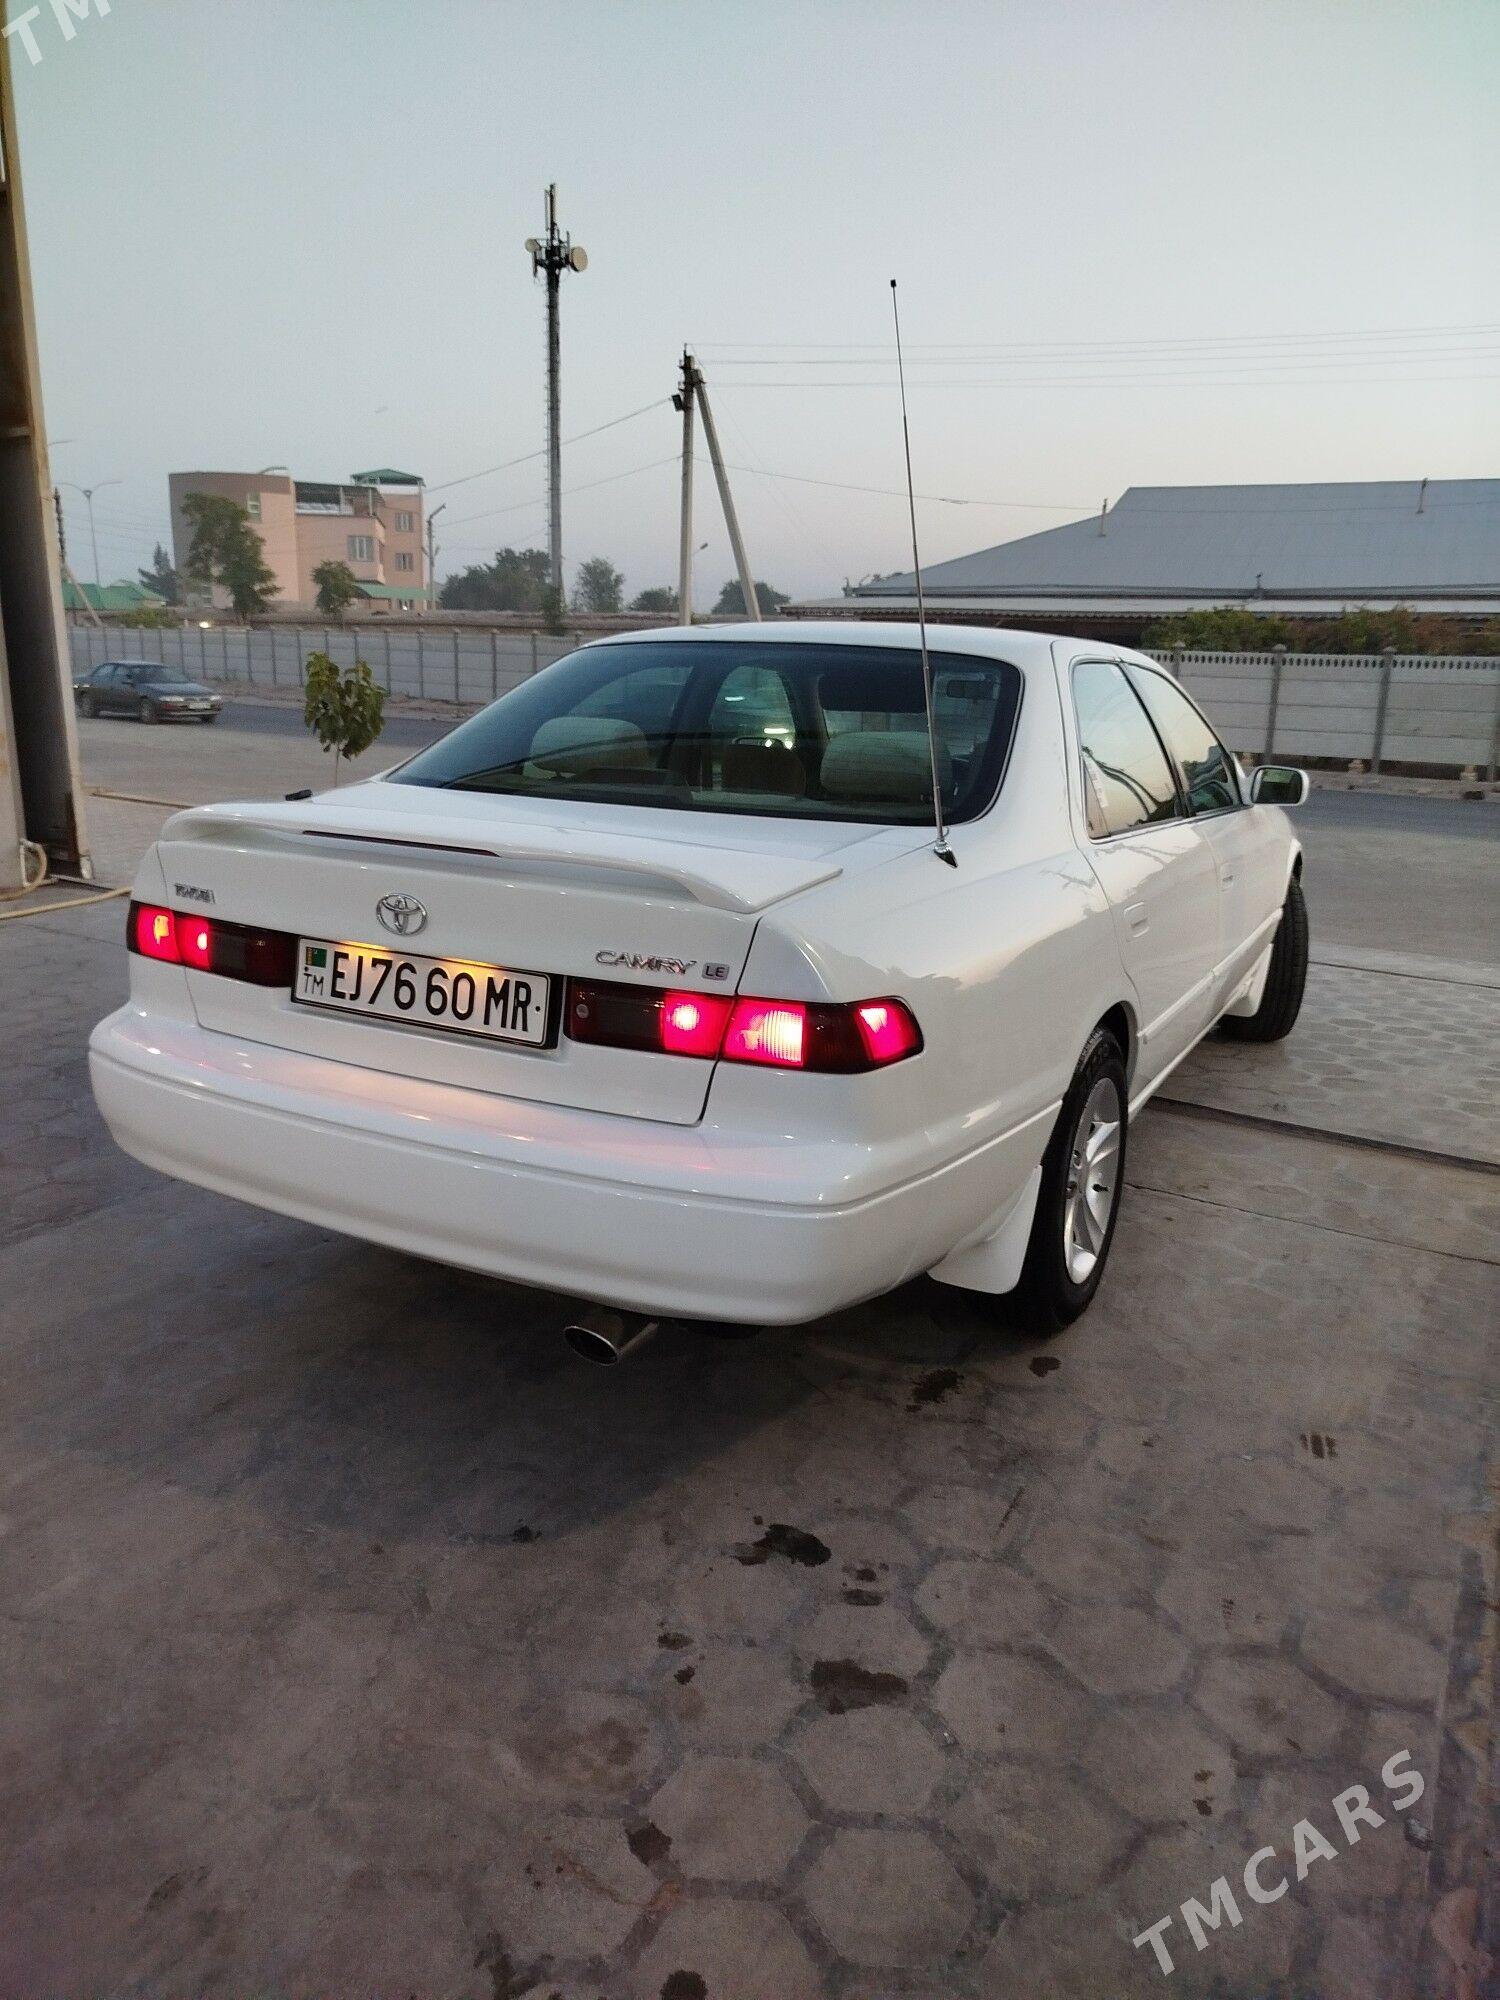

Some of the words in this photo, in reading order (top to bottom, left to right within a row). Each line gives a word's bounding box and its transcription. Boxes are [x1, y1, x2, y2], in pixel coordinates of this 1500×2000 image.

[595, 950, 698, 975] CAMRY
[704, 964, 726, 979] LE
[303, 972, 325, 996] TM
